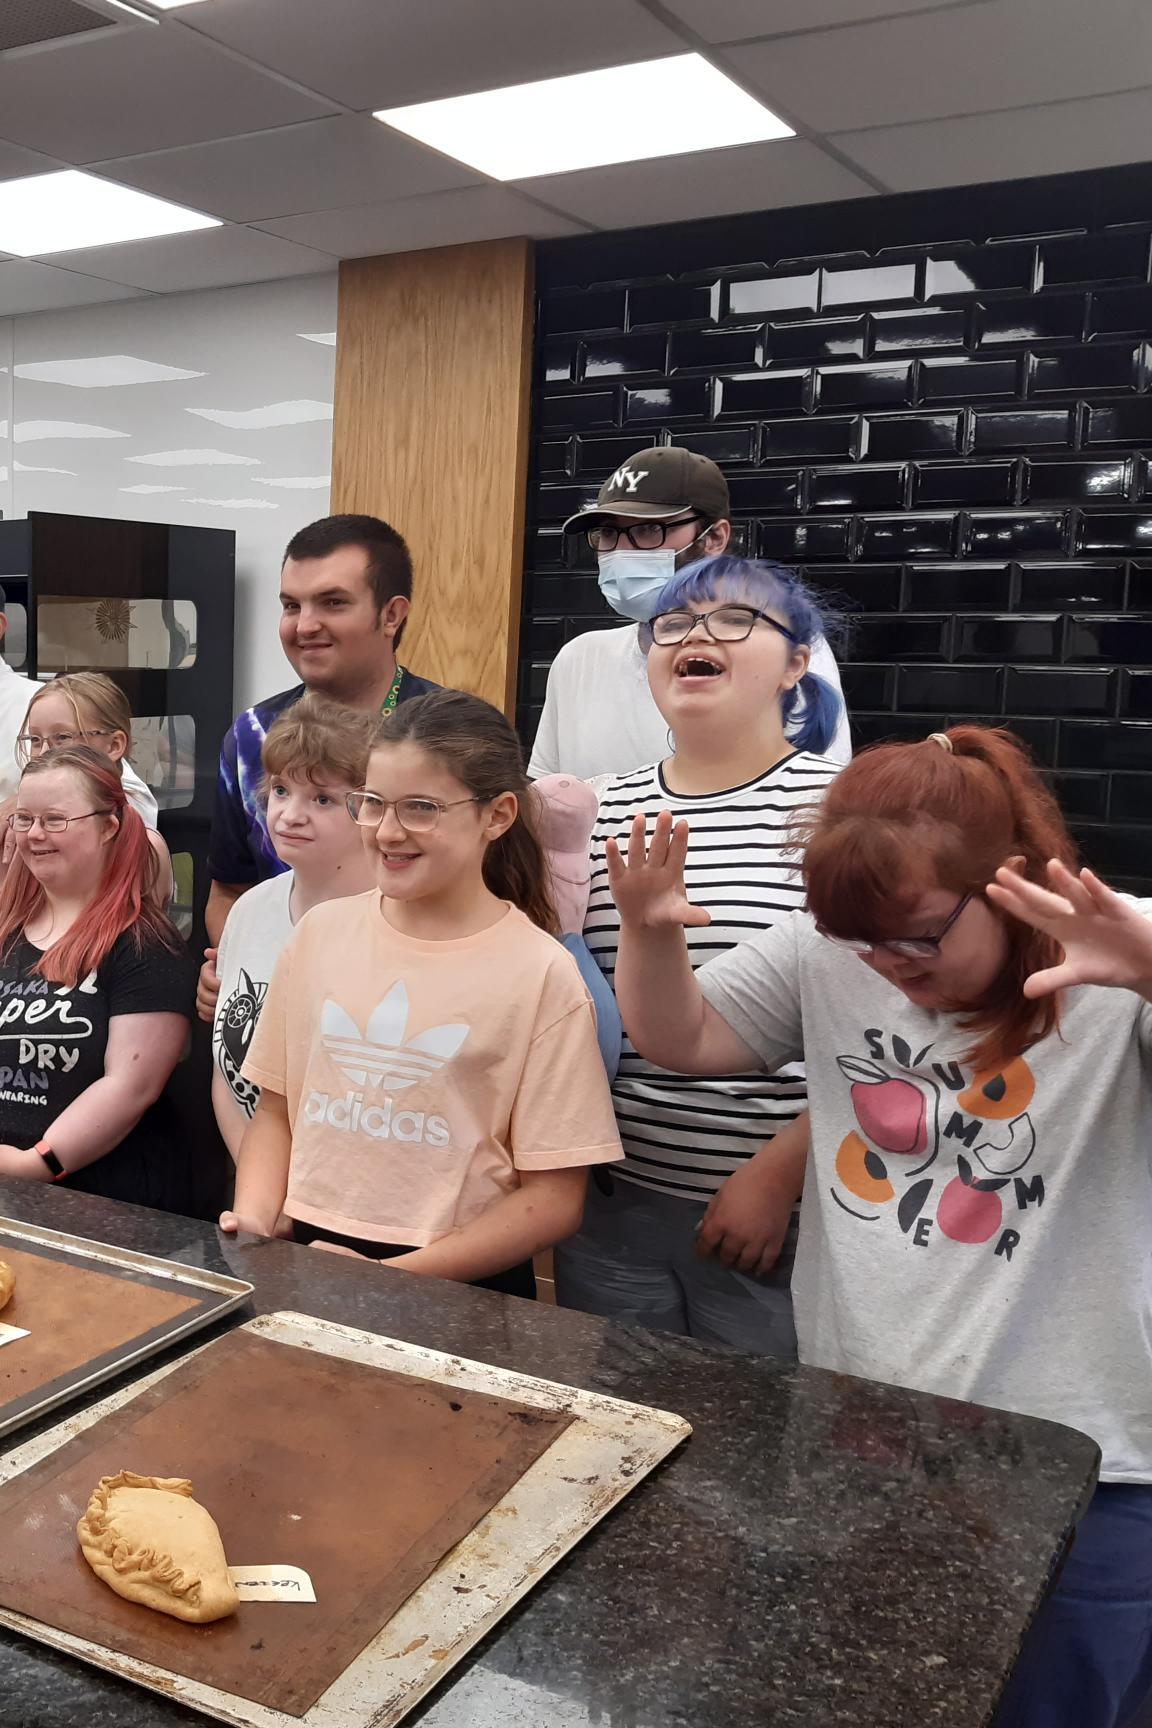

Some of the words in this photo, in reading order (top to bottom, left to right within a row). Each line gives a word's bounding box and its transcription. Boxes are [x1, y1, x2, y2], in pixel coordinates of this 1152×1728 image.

[608, 466, 649, 493] NY
[19, 1038, 80, 1073] DRY
[304, 1090, 450, 1147] adidas
